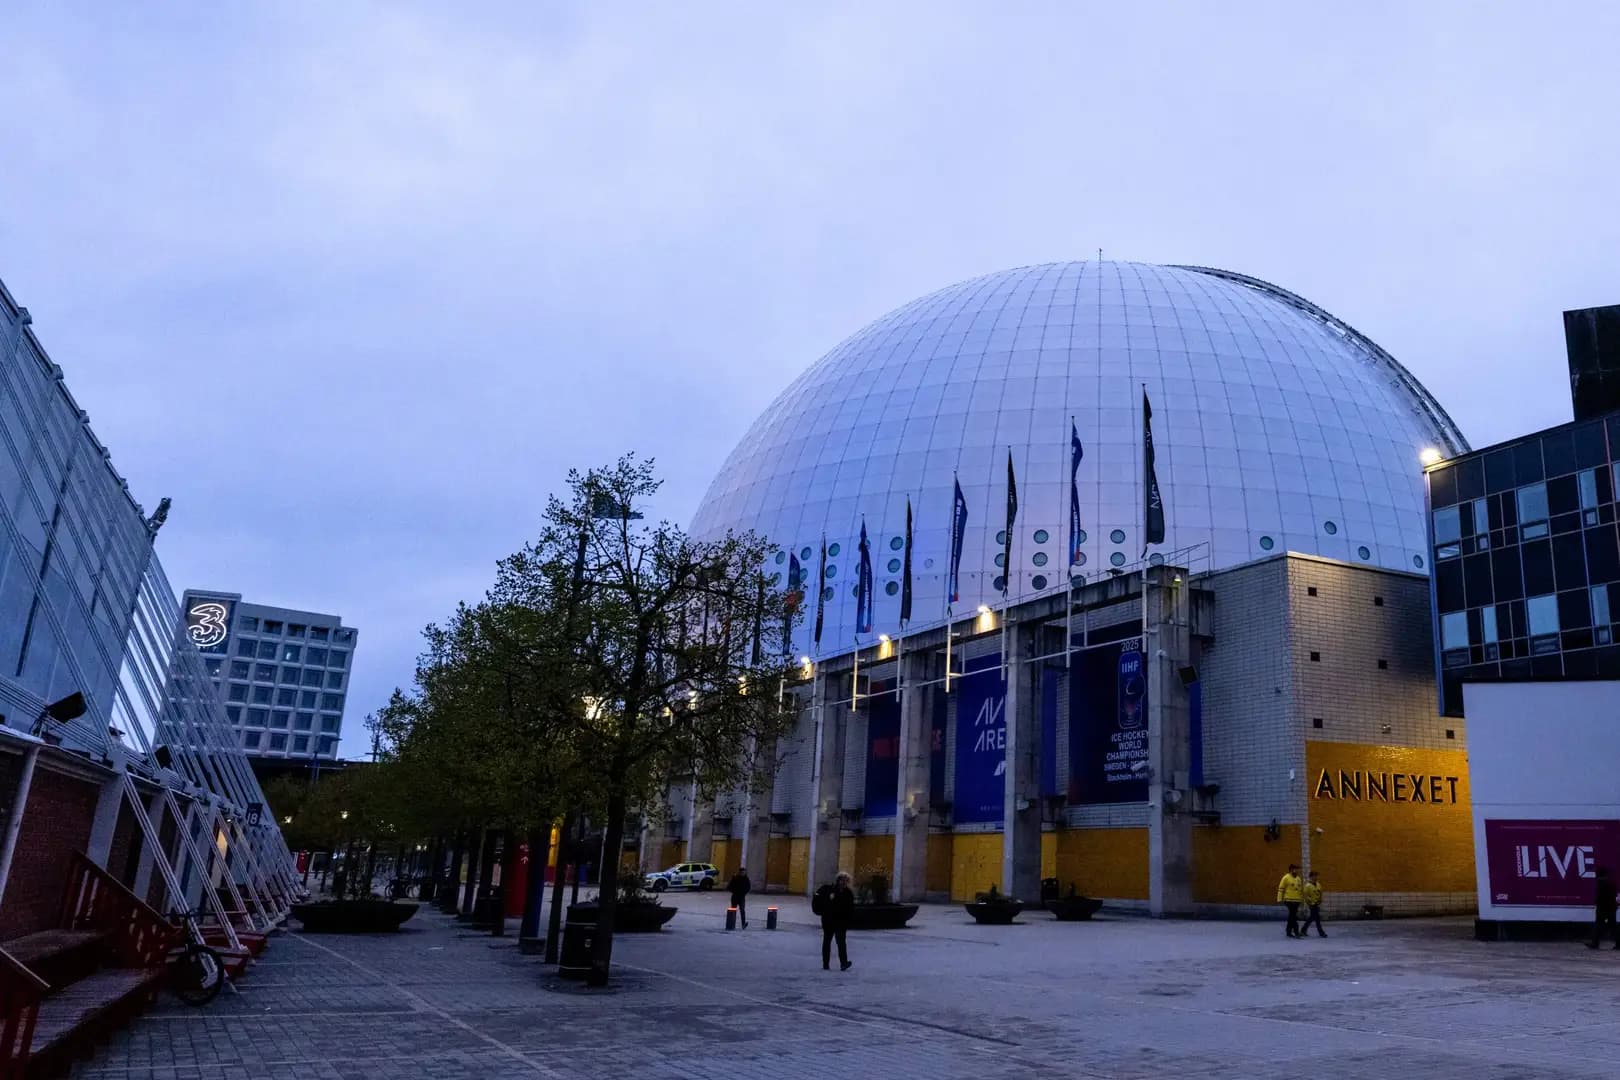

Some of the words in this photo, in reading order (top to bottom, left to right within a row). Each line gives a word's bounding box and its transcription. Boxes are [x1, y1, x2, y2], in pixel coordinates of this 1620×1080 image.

[1121, 640, 1139, 652] 2025
[1121, 660, 1139, 673] IIHF
[974, 727, 1005, 752] ARE
[1111, 732, 1122, 743] ICE
[1118, 739, 1142, 750] WORLD
[1106, 748, 1149, 761] CHAMPIONSH
[1314, 767, 1458, 804] ANNEXET
[1520, 845, 1597, 880] LIVE
